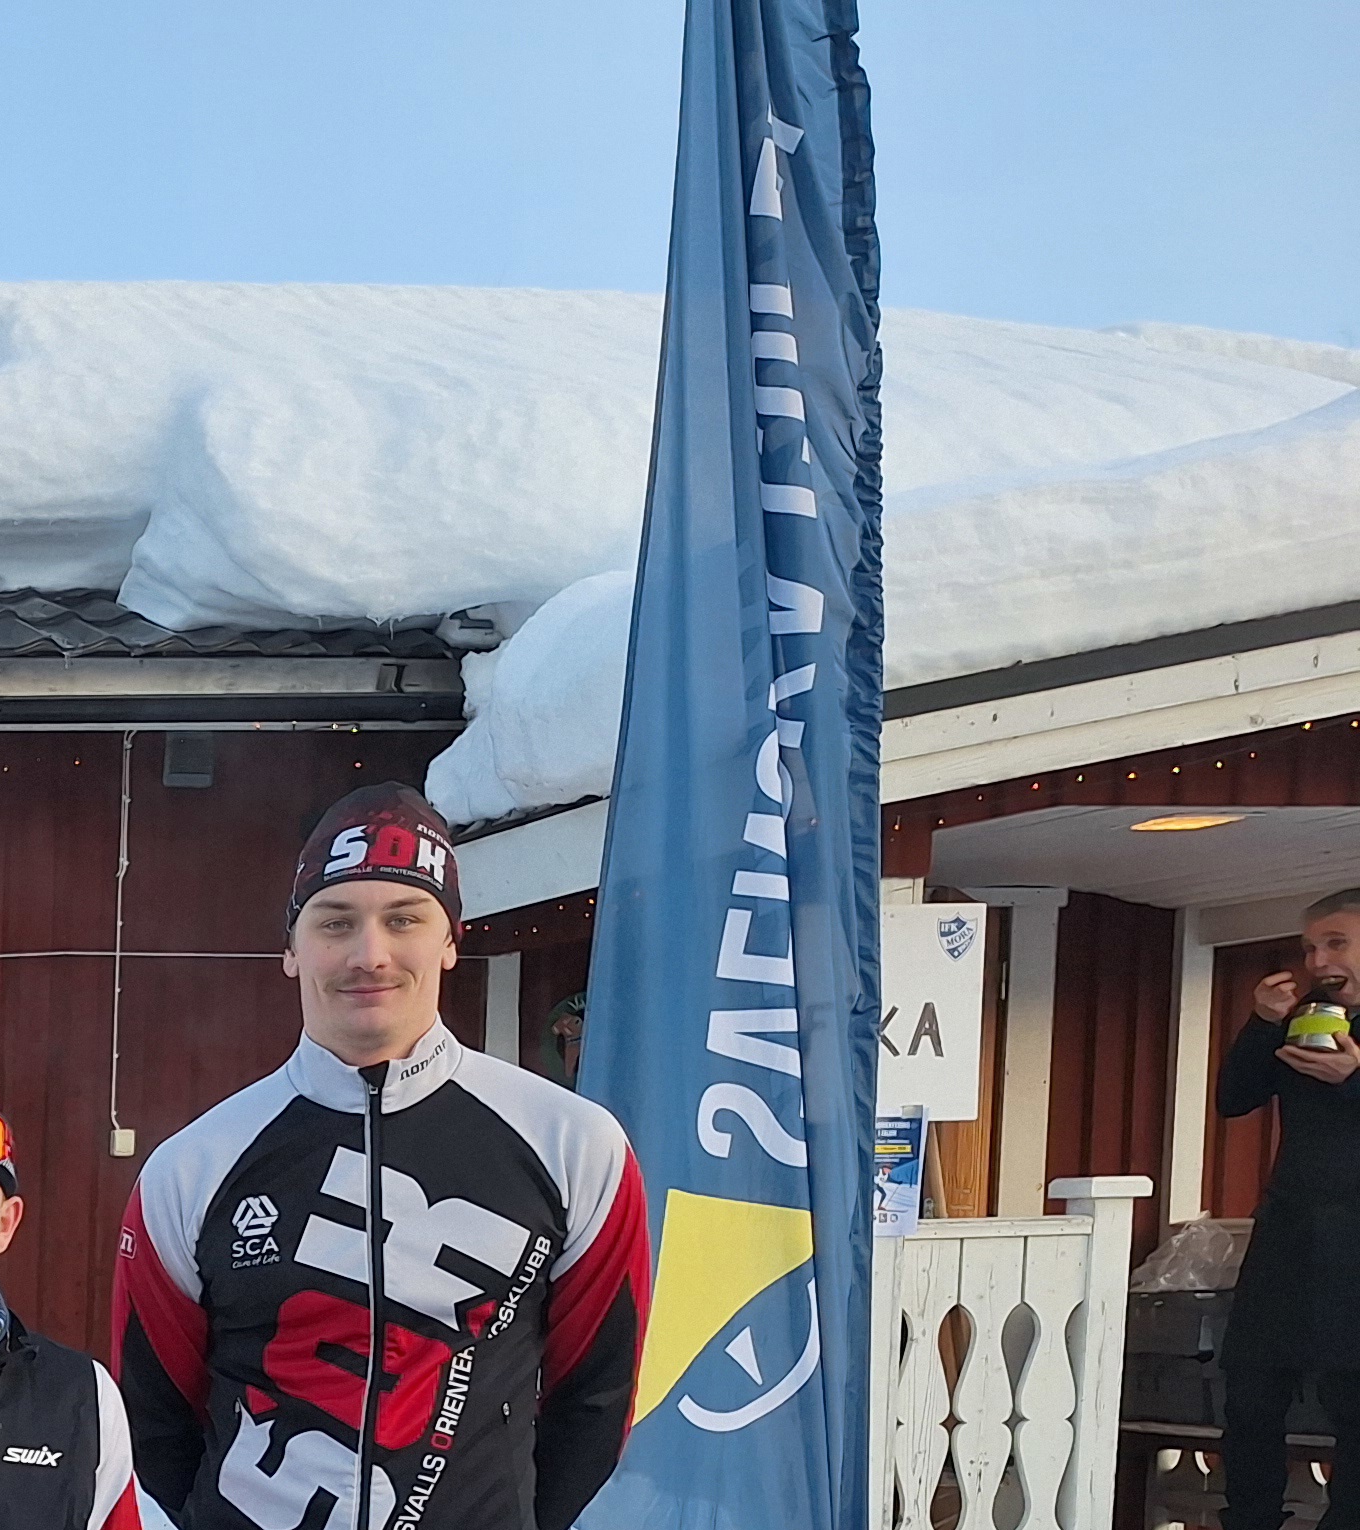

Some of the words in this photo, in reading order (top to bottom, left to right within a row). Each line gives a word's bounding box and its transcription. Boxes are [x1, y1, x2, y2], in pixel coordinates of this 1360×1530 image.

[323, 825, 447, 885] SOK
[940, 921, 959, 932] IFK
[945, 926, 974, 948] MORA
[231, 1236, 280, 1258] SCA
